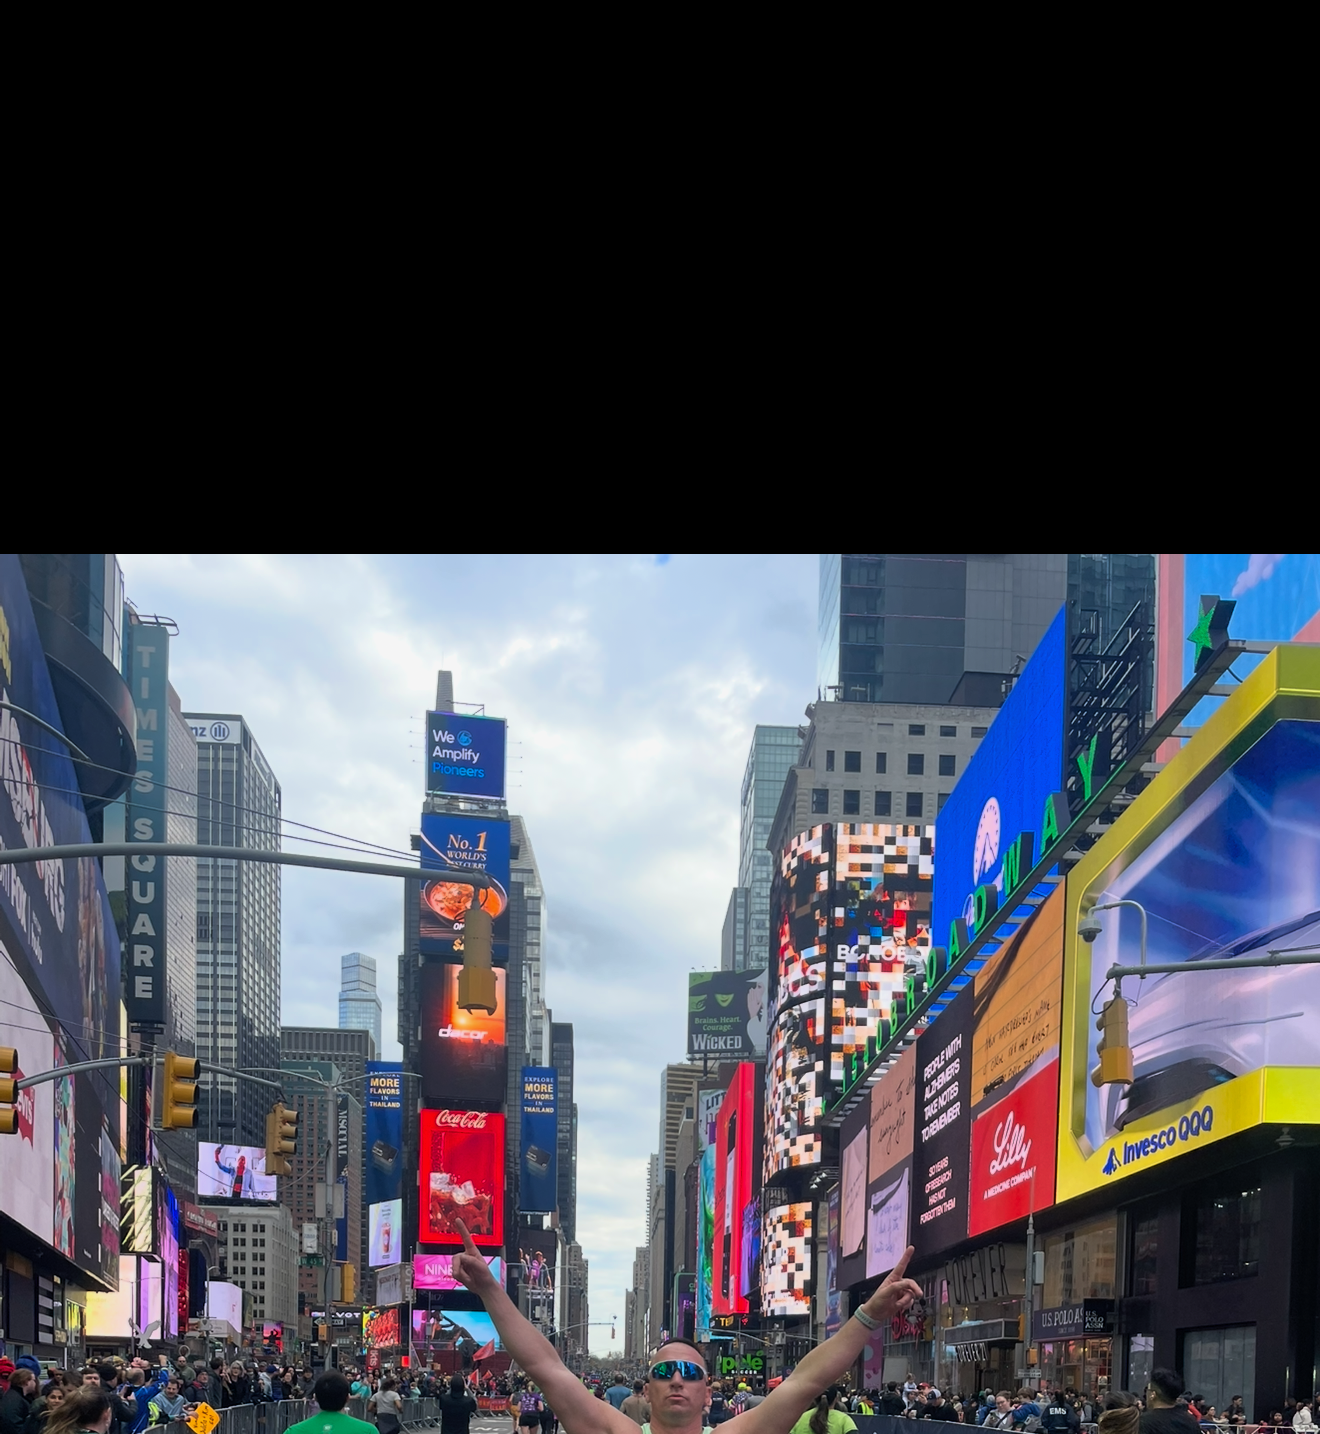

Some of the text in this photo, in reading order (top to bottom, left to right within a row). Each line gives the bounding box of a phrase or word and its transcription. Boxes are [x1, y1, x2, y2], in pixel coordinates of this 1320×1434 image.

[135, 646, 157, 793] TIMES
[433, 730, 455, 744] We
[433, 746, 480, 764] Amplify
[433, 762, 485, 778] Pioneers
[447, 831, 488, 852] No. 1
[447, 850, 487, 861] WORLD'S
[890, 733, 1098, 1033] BROADWAY
[131, 818, 157, 998] SQUARE
[702, 1024, 733, 1032] Courage.
[720, 1016, 742, 1024] Heart.
[438, 1024, 488, 1041] dacor
[923, 1051, 945, 1082] PEOPLE
[945, 1034, 962, 1064] WITH
[369, 1087, 400, 1095] FLAVORS
[370, 1078, 400, 1087] MORE
[524, 1083, 553, 1092] MORE
[923, 1098, 938, 1121] TAKE
[938, 1081, 960, 1114] NOTES
[930, 1101, 961, 1136] REMEMBER
[990, 1110, 1032, 1176] Lilly
[1122, 1105, 1213, 1165] Invesco QQQ
[931, 1169, 952, 1190] RESEARCH
[919, 1204, 943, 1225] FORGOTTEN
[1041, 1312, 1053, 1328] U.S.
[1054, 1309, 1074, 1326] POLO
[1049, 1407, 1067, 1415] EMS
